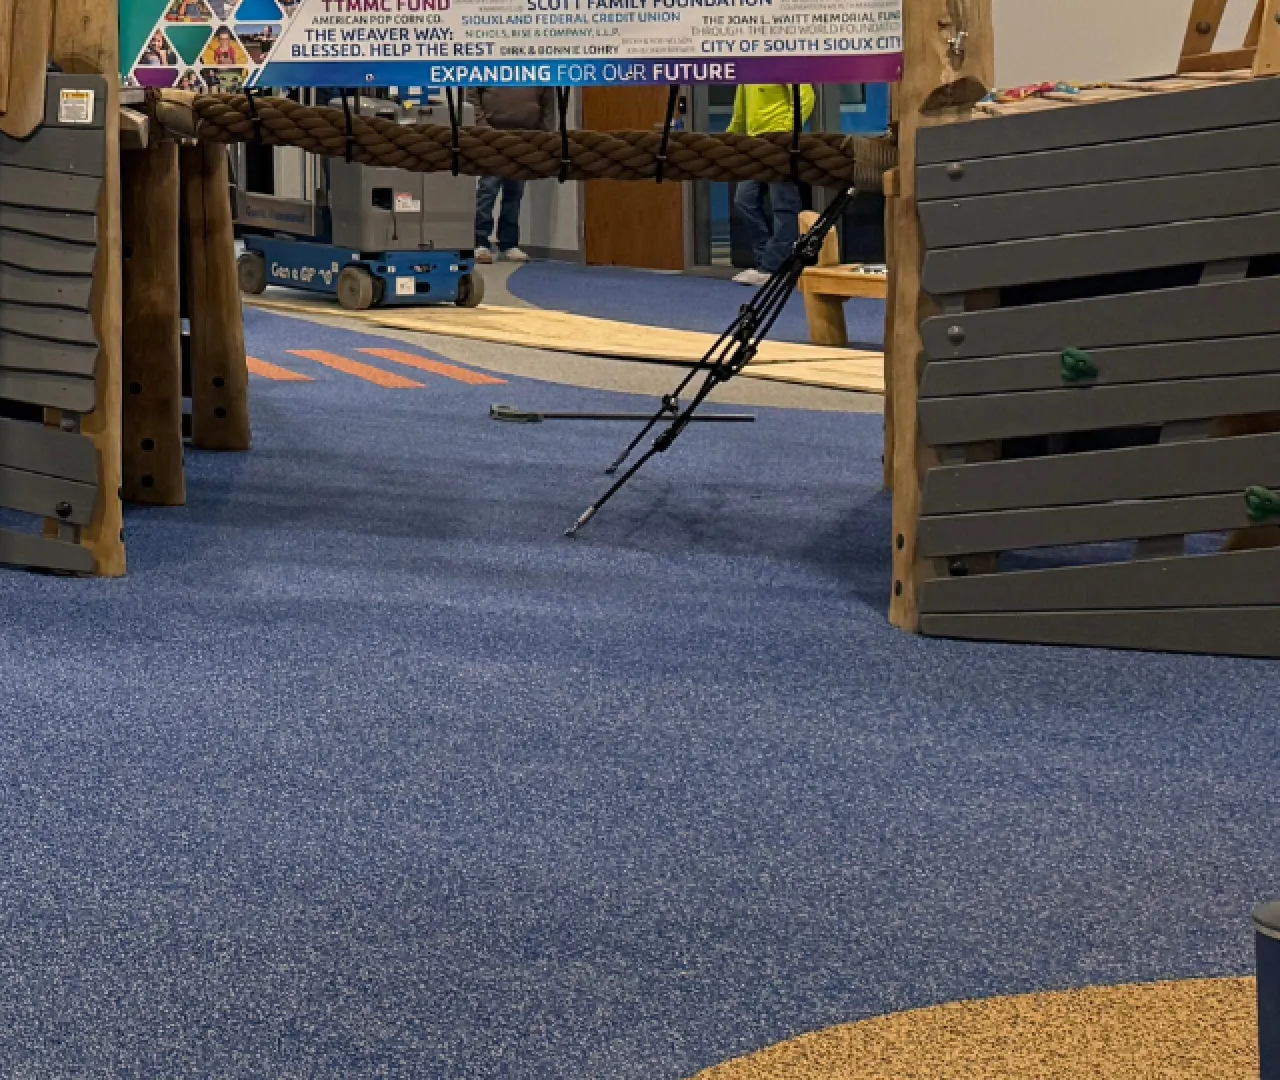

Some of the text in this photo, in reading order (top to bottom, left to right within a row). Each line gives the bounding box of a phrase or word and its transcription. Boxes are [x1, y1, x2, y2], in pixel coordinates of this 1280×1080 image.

[311, 14, 444, 25] AMERICAN POP CORN CO.
[461, 11, 681, 26] SIOUXLAND FEDERAL CREDIT UNION
[701, 15, 725, 25] THE
[726, 15, 757, 25] JOAN
[772, 13, 810, 24] WAITT
[811, 11, 875, 24] MEMORIAL
[303, 26, 454, 42] THE WEAVER WAY:
[465, 29, 510, 39] NICHOLS,
[691, 22, 901, 36] THROUGH THE KIND WORLD FOUNDATIO
[291, 41, 496, 57] BLESSED. HELP THE REST
[499, 45, 527, 56] DIRK
[536, 45, 581, 55] BONNIE
[583, 45, 619, 55] LOHRY
[701, 39, 736, 53] CITY
[739, 39, 759, 52] OF
[763, 38, 819, 52] SOUTH
[823, 37, 873, 51] SIOUX
[430, 62, 737, 83] EXPANDING FOR OUR FUTURE
